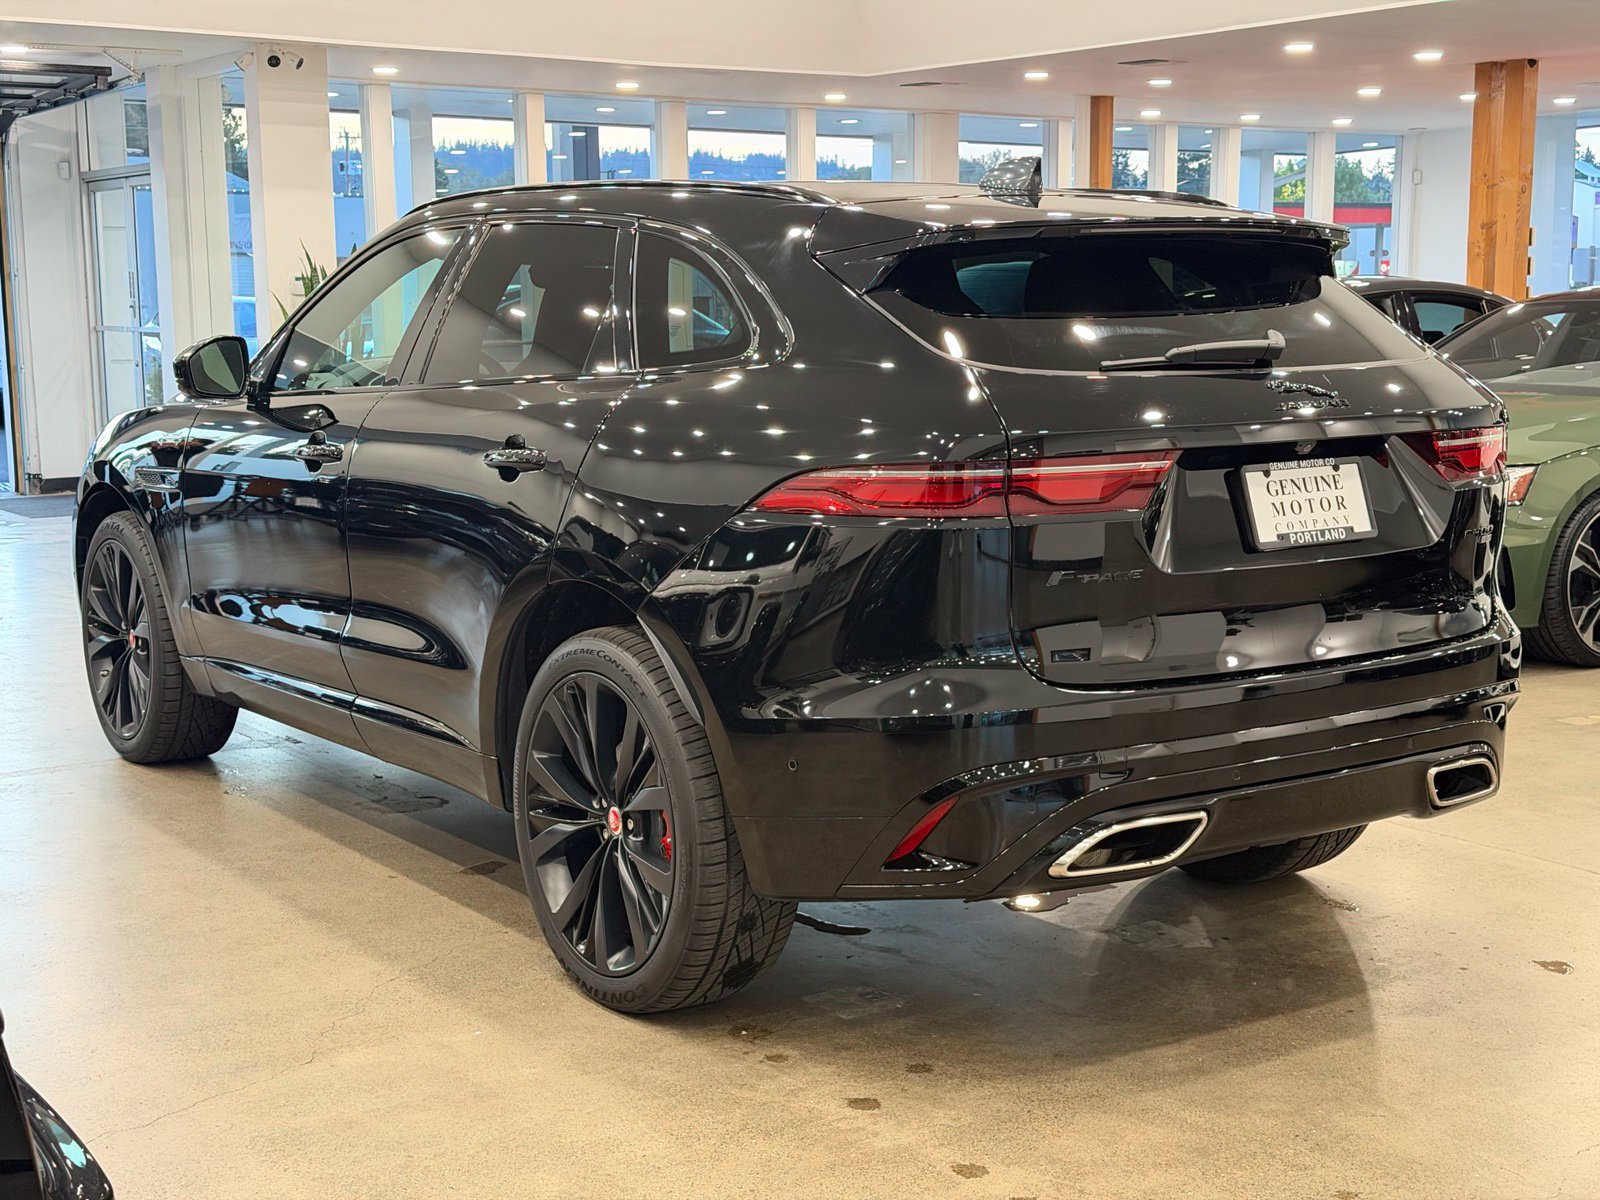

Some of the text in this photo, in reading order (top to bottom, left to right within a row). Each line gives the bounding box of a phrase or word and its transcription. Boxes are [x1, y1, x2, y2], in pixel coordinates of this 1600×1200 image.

[1269, 457, 1335, 471] GENUINE MOTOR CO
[1266, 474, 1344, 497] GENUINE
[1271, 495, 1347, 518] MOTOR
[1275, 514, 1351, 533] COMPANY
[1289, 528, 1346, 544] PORTLAND
